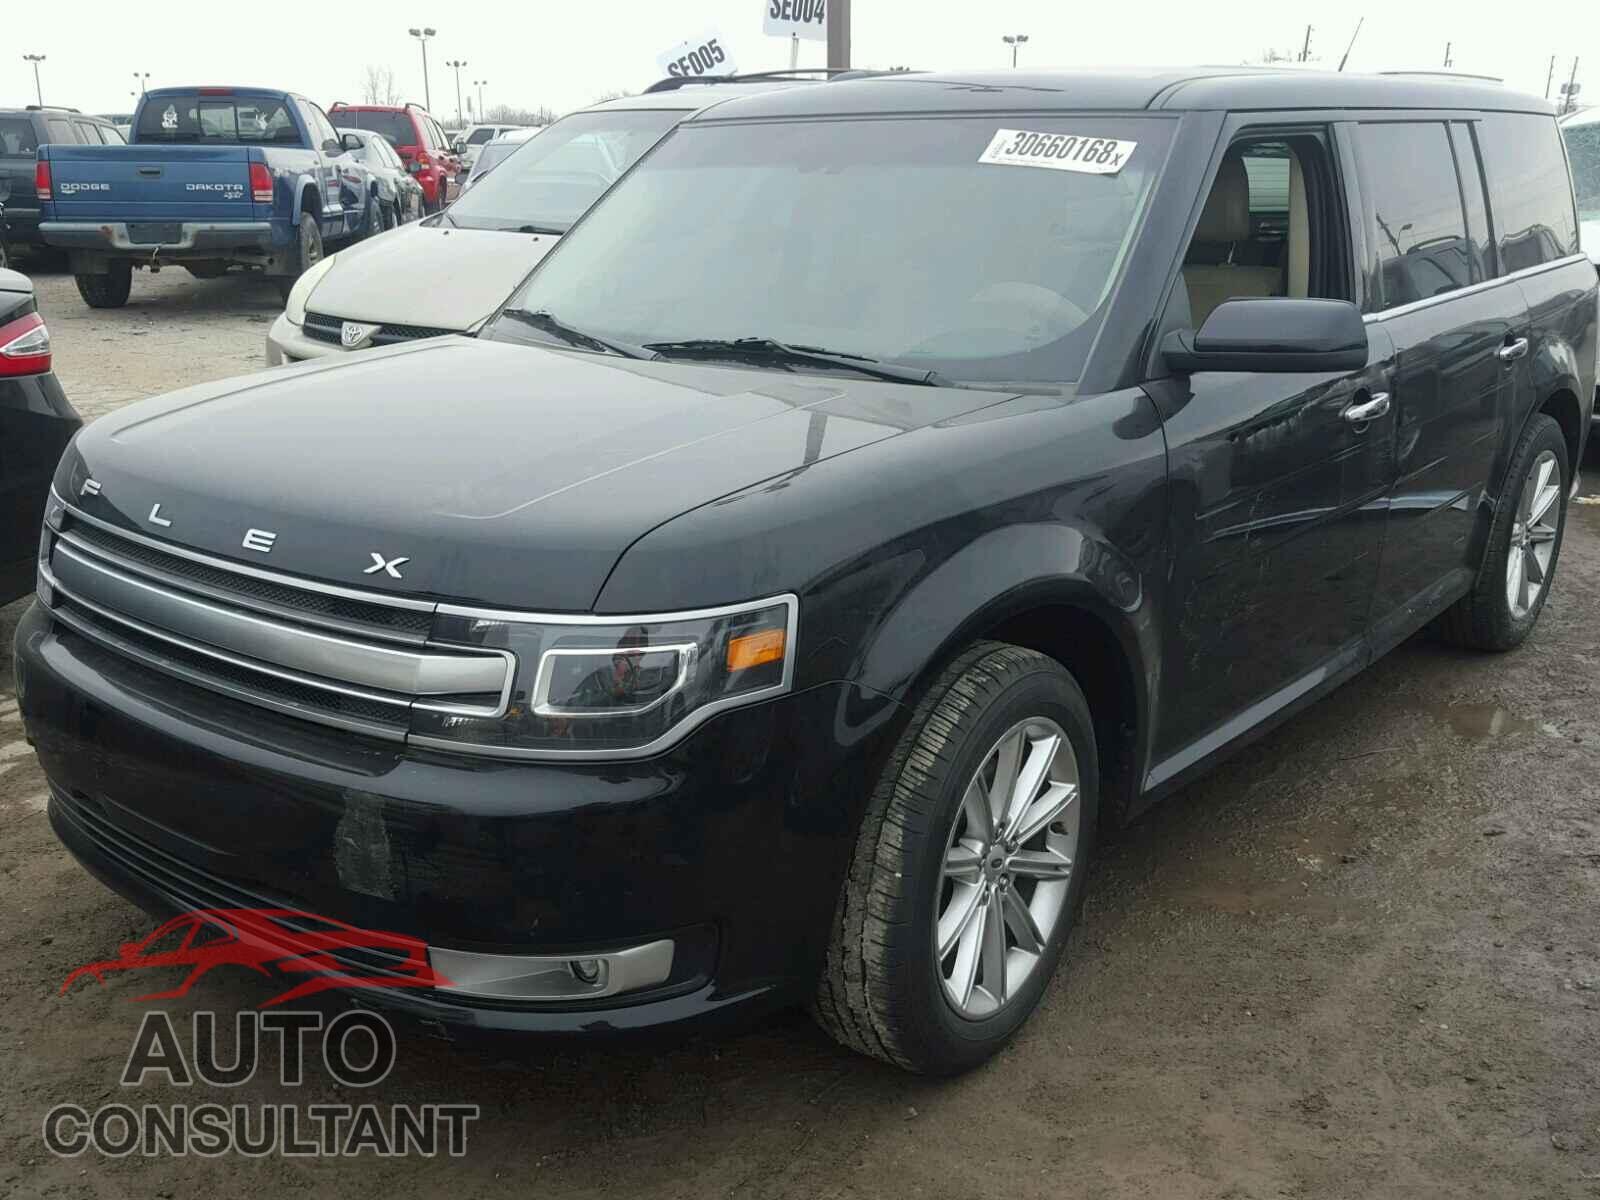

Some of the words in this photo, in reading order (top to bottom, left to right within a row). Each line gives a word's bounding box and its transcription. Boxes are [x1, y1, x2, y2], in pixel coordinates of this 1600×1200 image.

[769, 0, 825, 24] SE004
[60, 182, 111, 191] DODGE
[185, 183, 243, 191] DAKOTA
[79, 477, 410, 579] FLEX
